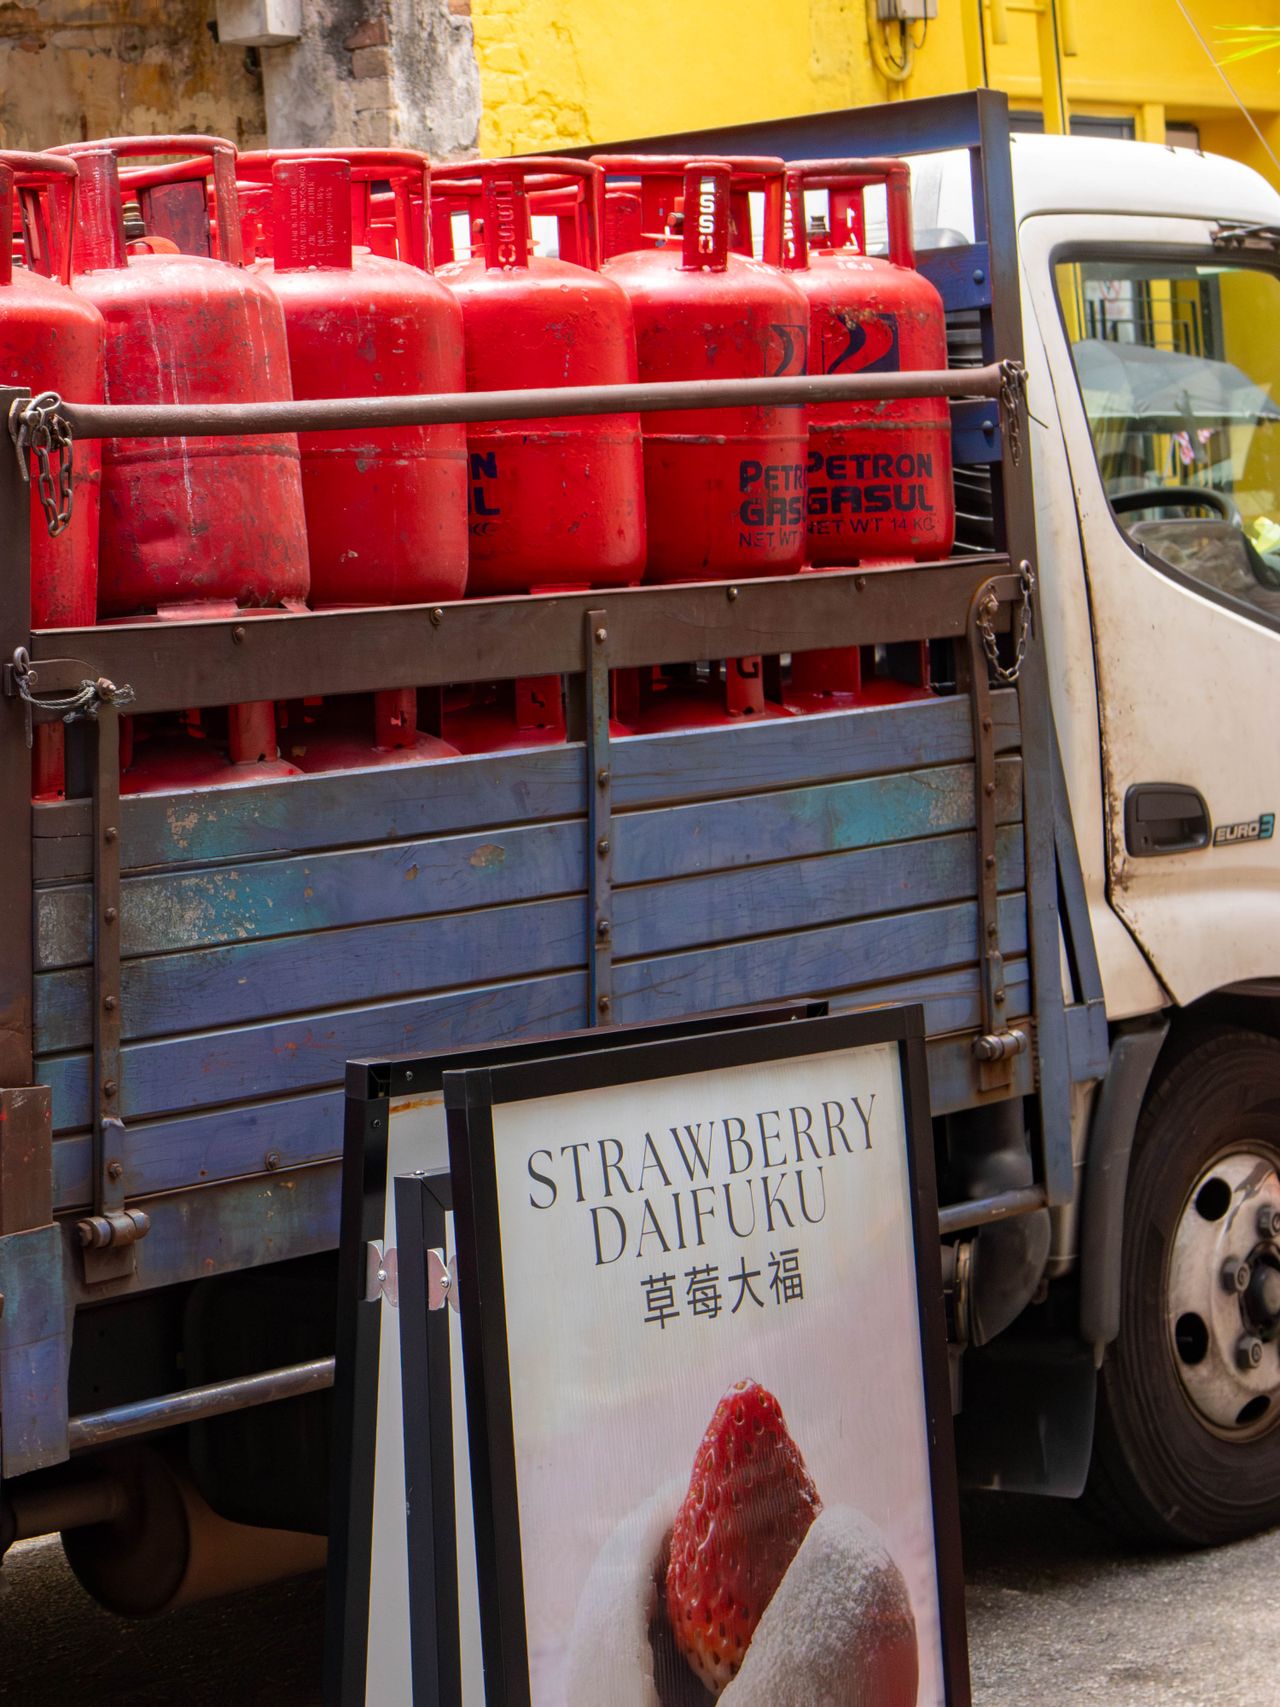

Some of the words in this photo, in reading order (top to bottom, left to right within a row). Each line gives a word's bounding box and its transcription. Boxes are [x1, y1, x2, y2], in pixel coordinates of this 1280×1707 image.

[739, 460, 807, 493] PETR
[739, 496, 807, 527] GAS
[850, 517, 883, 534] WT
[892, 516, 907, 531] 14
[913, 514, 935, 531] KG
[740, 532, 774, 548] NET
[527, 1093, 876, 1210] STRAWBERRY
[590, 1166, 827, 1266] DAIFUKU
[640, 1248, 804, 1329] 草莓大福
